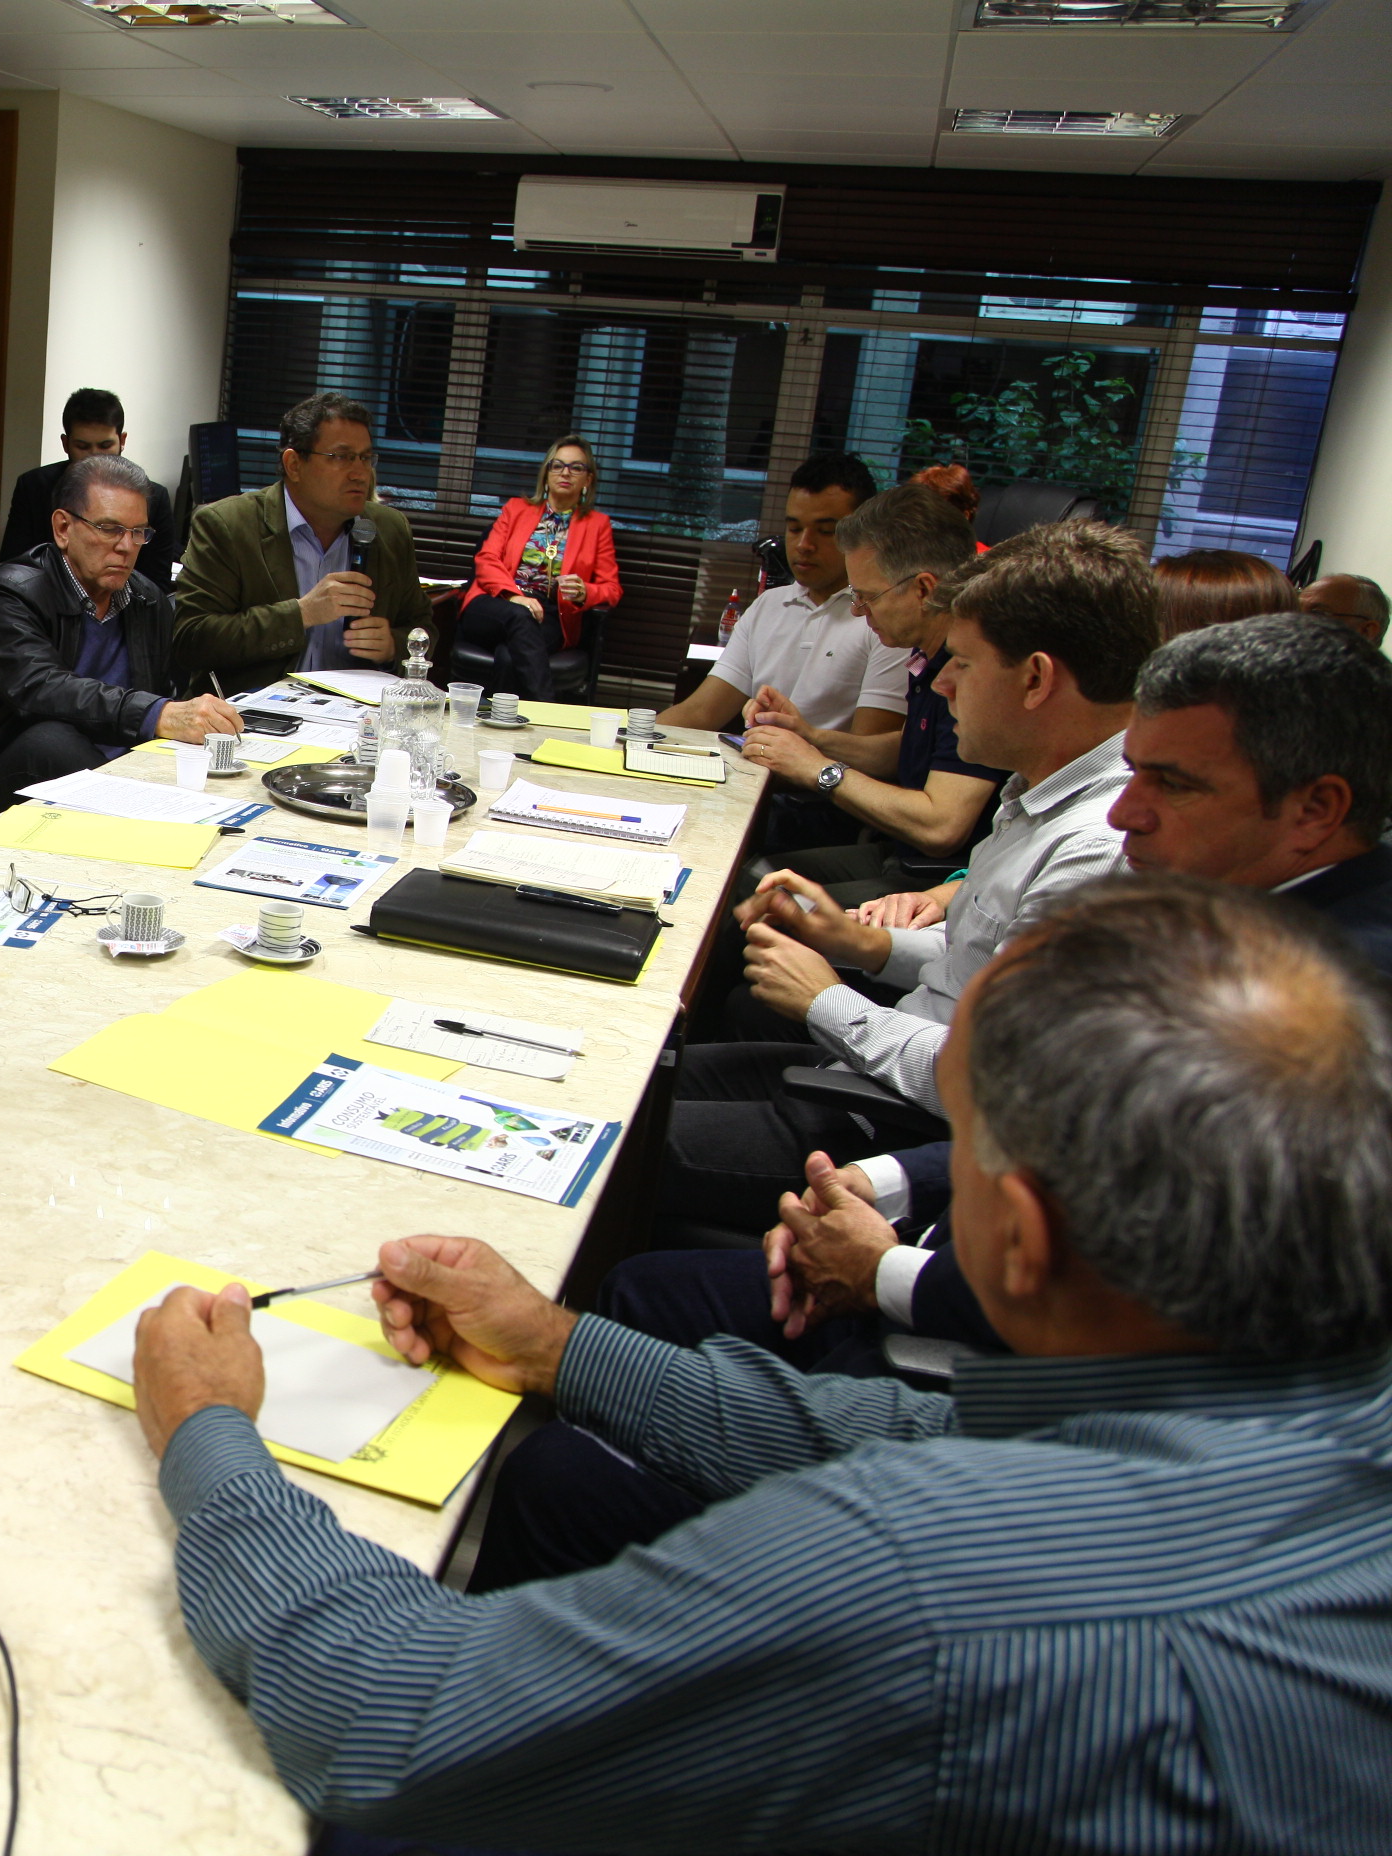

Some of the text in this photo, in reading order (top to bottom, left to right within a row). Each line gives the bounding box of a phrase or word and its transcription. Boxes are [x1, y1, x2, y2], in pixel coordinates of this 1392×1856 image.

[275, 1101, 313, 1128] Informativo
[331, 1091, 375, 1126] CONSUMO
[498, 1153, 517, 1171] ARIS
